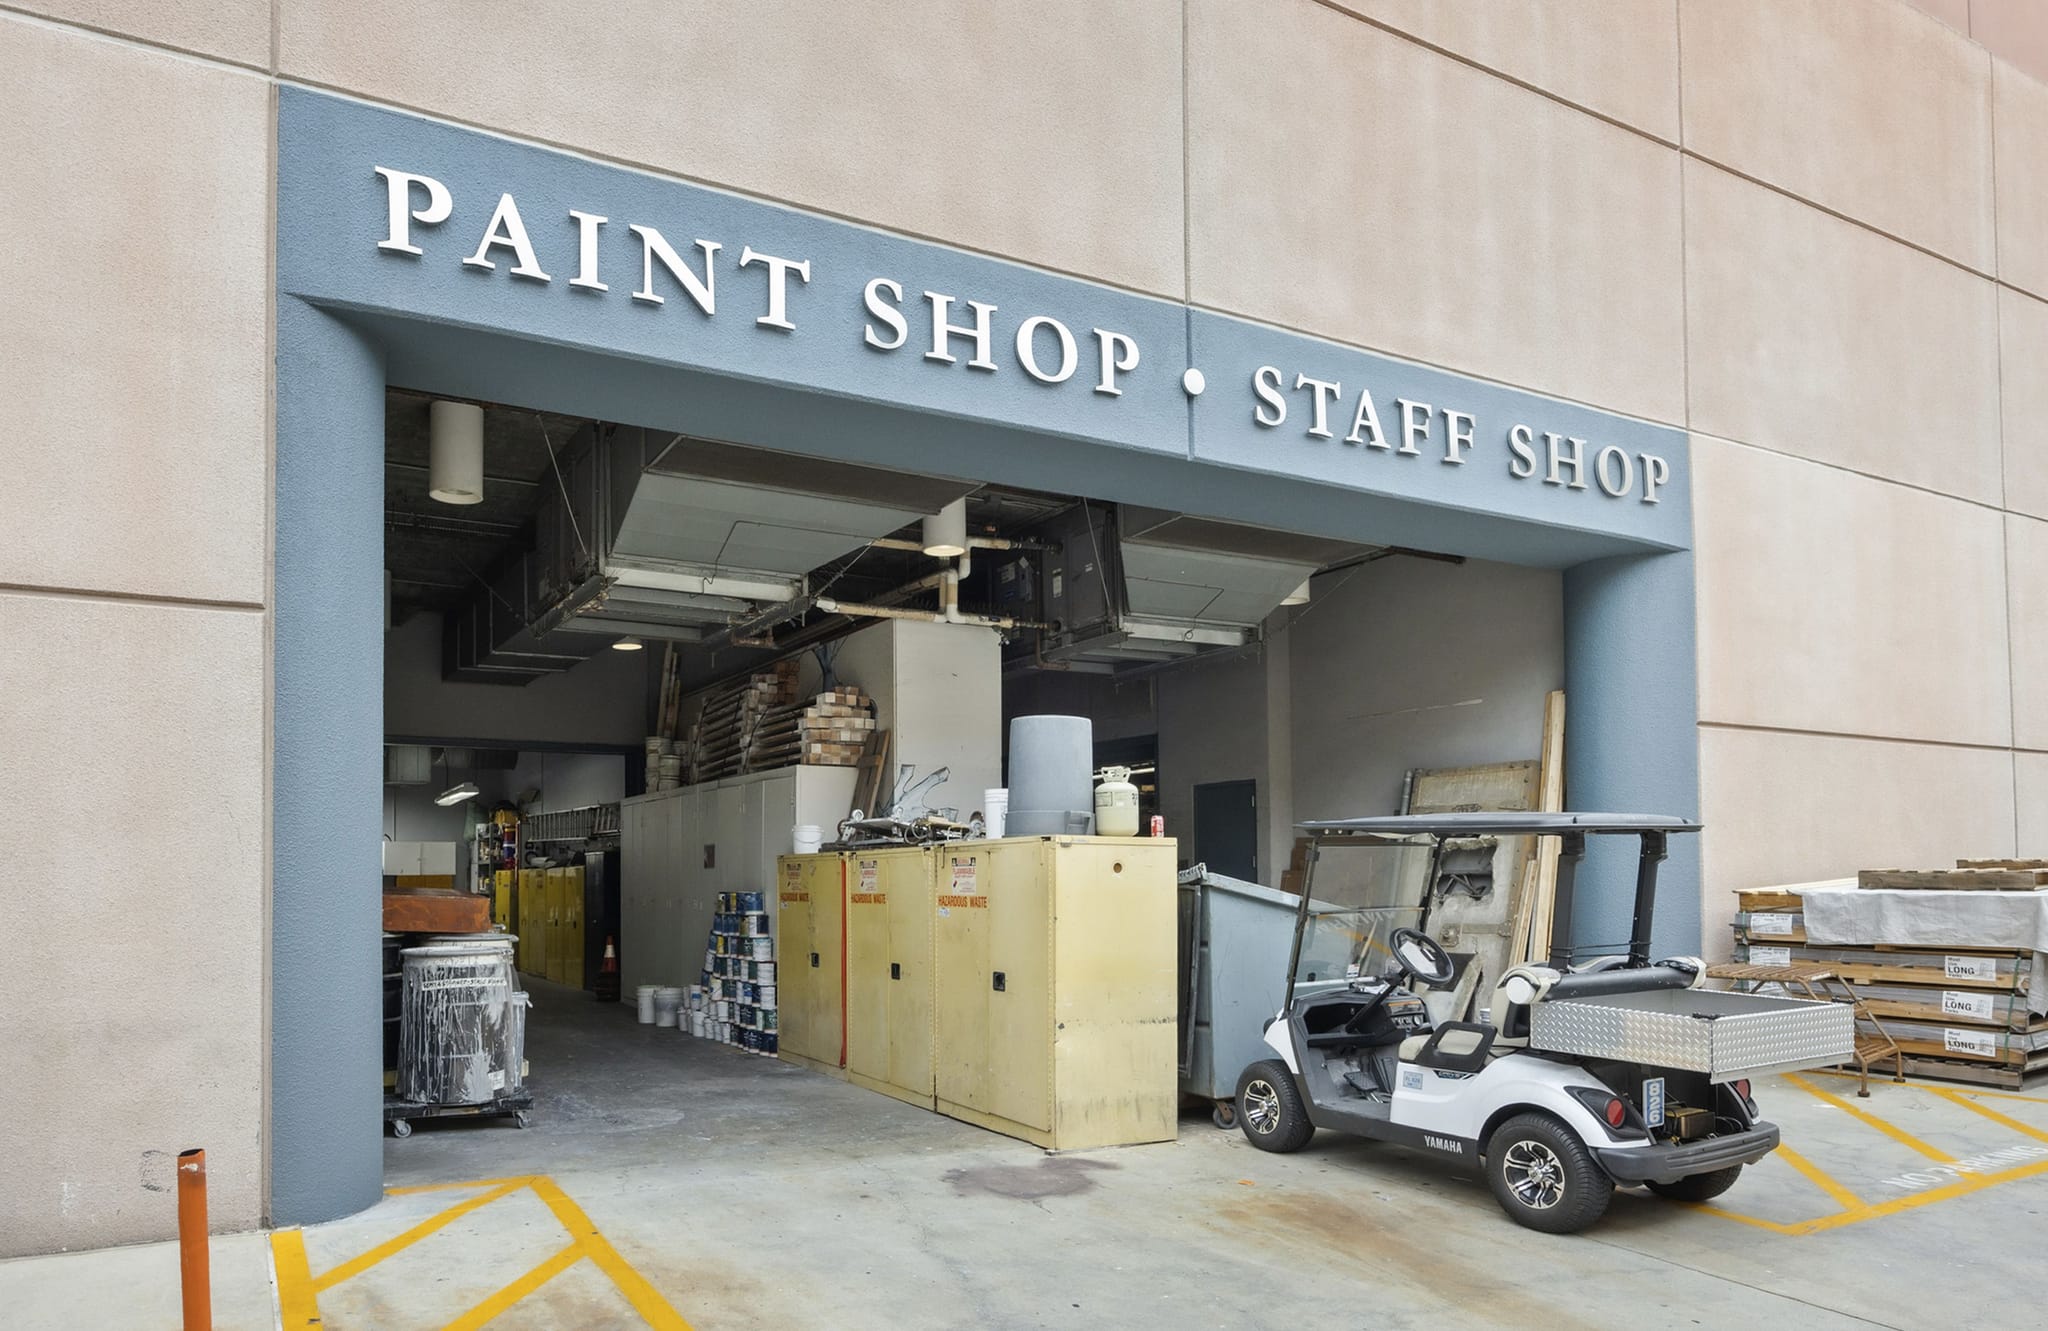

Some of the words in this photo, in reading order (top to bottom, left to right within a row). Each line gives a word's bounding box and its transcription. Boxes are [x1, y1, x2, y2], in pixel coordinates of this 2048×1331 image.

[374, 165, 811, 332] PAINT
[863, 277, 1140, 397] SHOP
[1253, 365, 1476, 465] STAFF
[1508, 423, 1670, 504] SHOP
[938, 895, 968, 908] HAZARDOUS
[969, 896, 988, 909] WASTE
[1948, 966, 1975, 975] LONG
[1945, 1001, 1972, 1011] LONG
[1947, 1040, 1975, 1050] LONG
[1649, 1082, 1661, 1124] 826
[1424, 1134, 1463, 1154] YAMAHA
[1880, 1172, 1943, 1189] NO
[1925, 1145, 2048, 1177] PARKING
